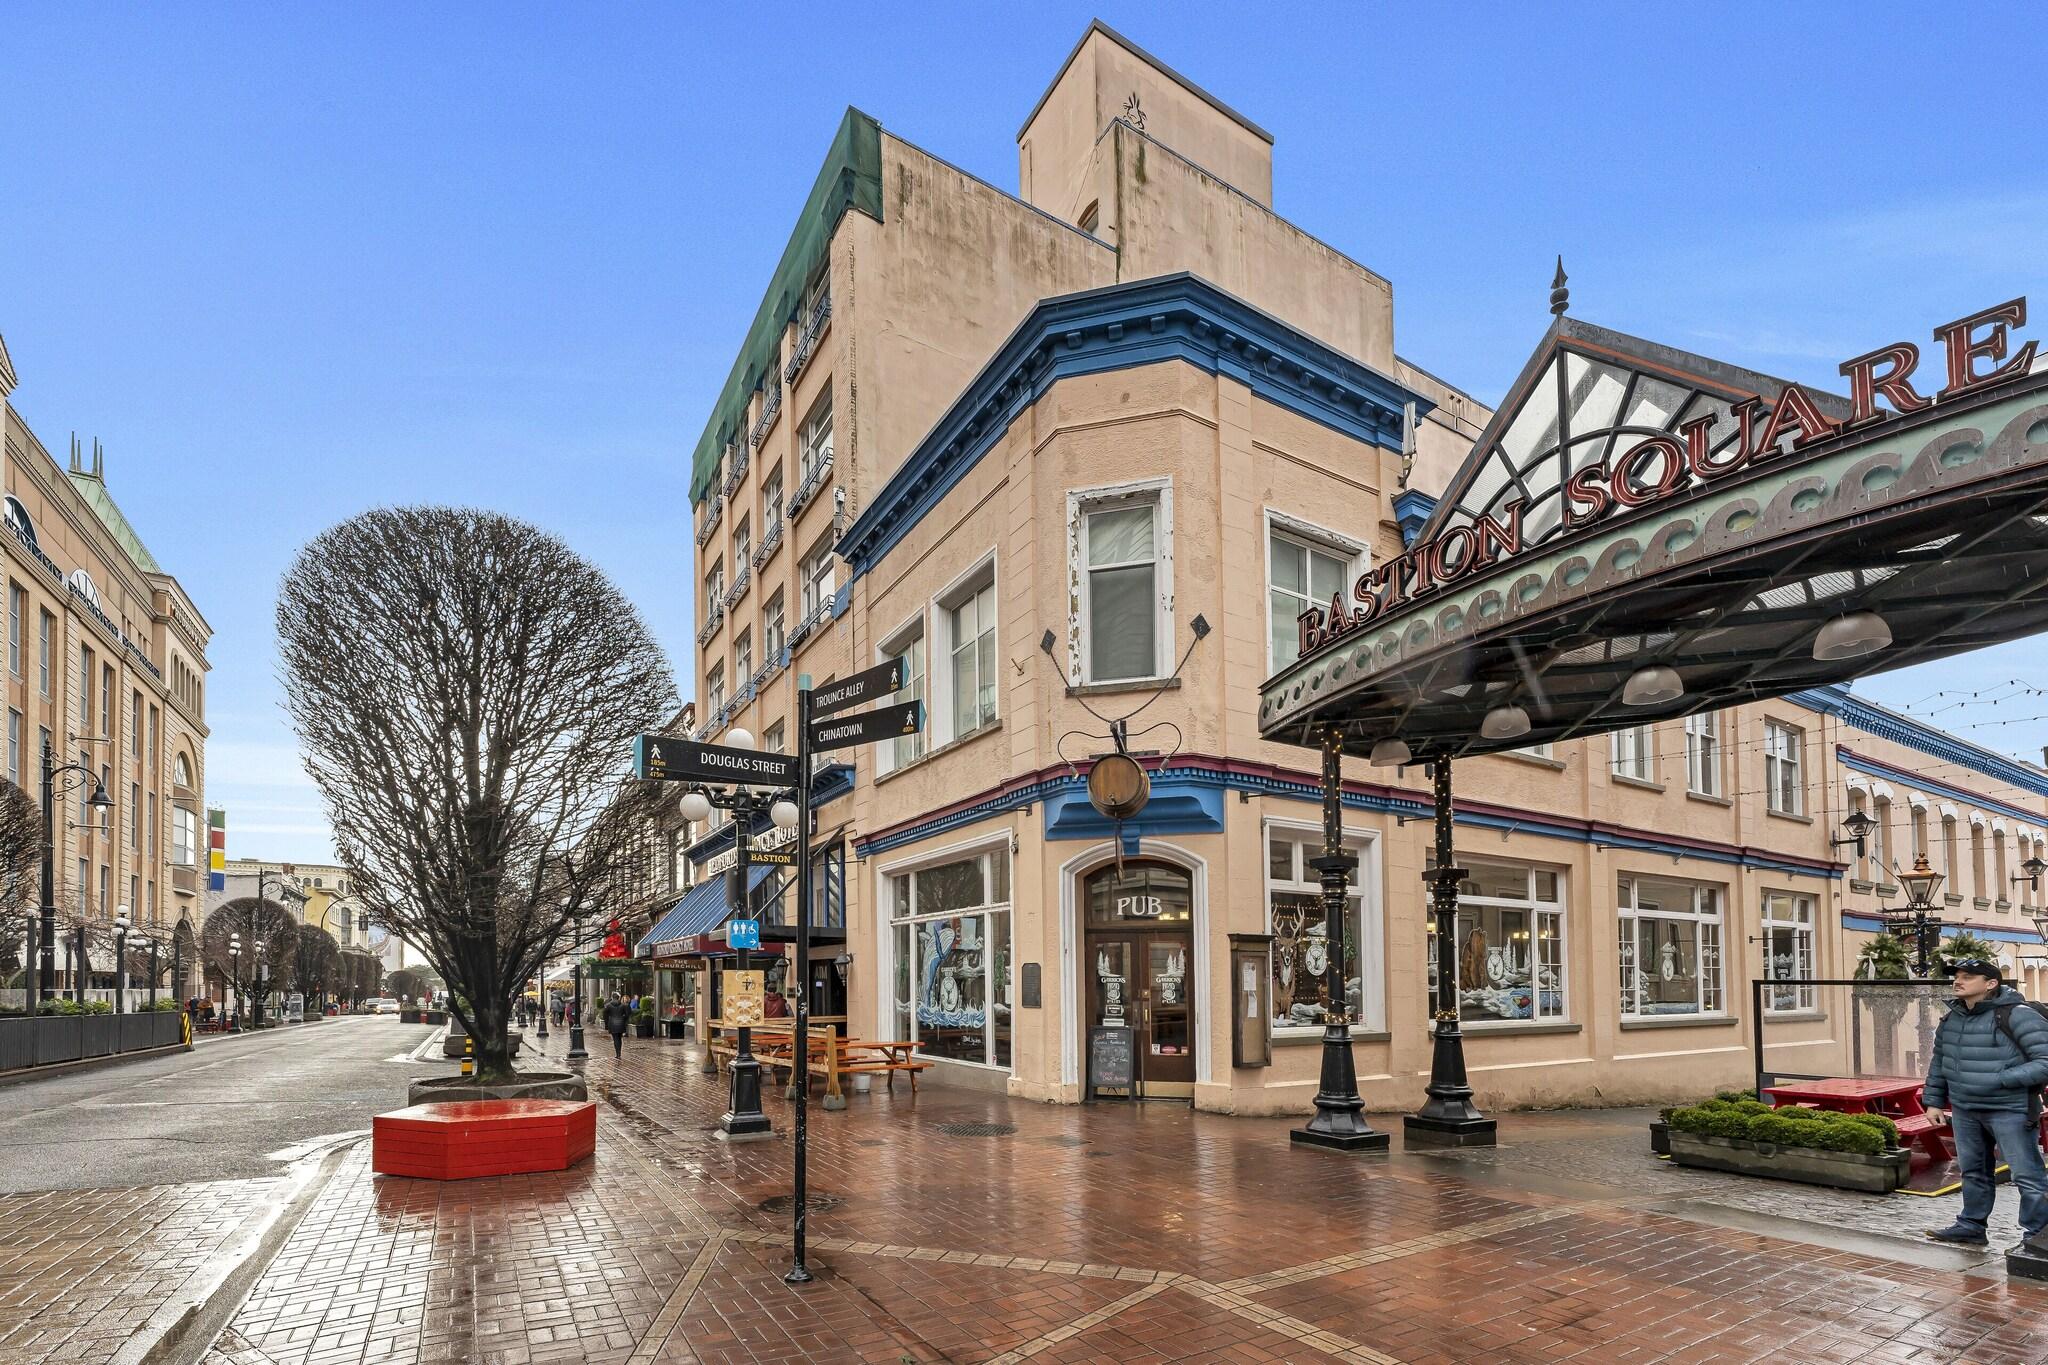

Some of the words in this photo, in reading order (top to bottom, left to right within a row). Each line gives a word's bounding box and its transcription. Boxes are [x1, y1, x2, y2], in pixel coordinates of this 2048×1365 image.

[1297, 496, 1529, 658] BASTION
[1564, 296, 2039, 529] SQUARE
[816, 688, 845, 708] TROUNCE
[845, 681, 865, 698] ALLEY
[818, 723, 863, 742] CHINATOWN
[701, 752, 750, 770] DOUGLAS
[751, 759, 787, 775] STREET
[751, 854, 791, 863] BASTION
[1117, 896, 1162, 915] PUB
